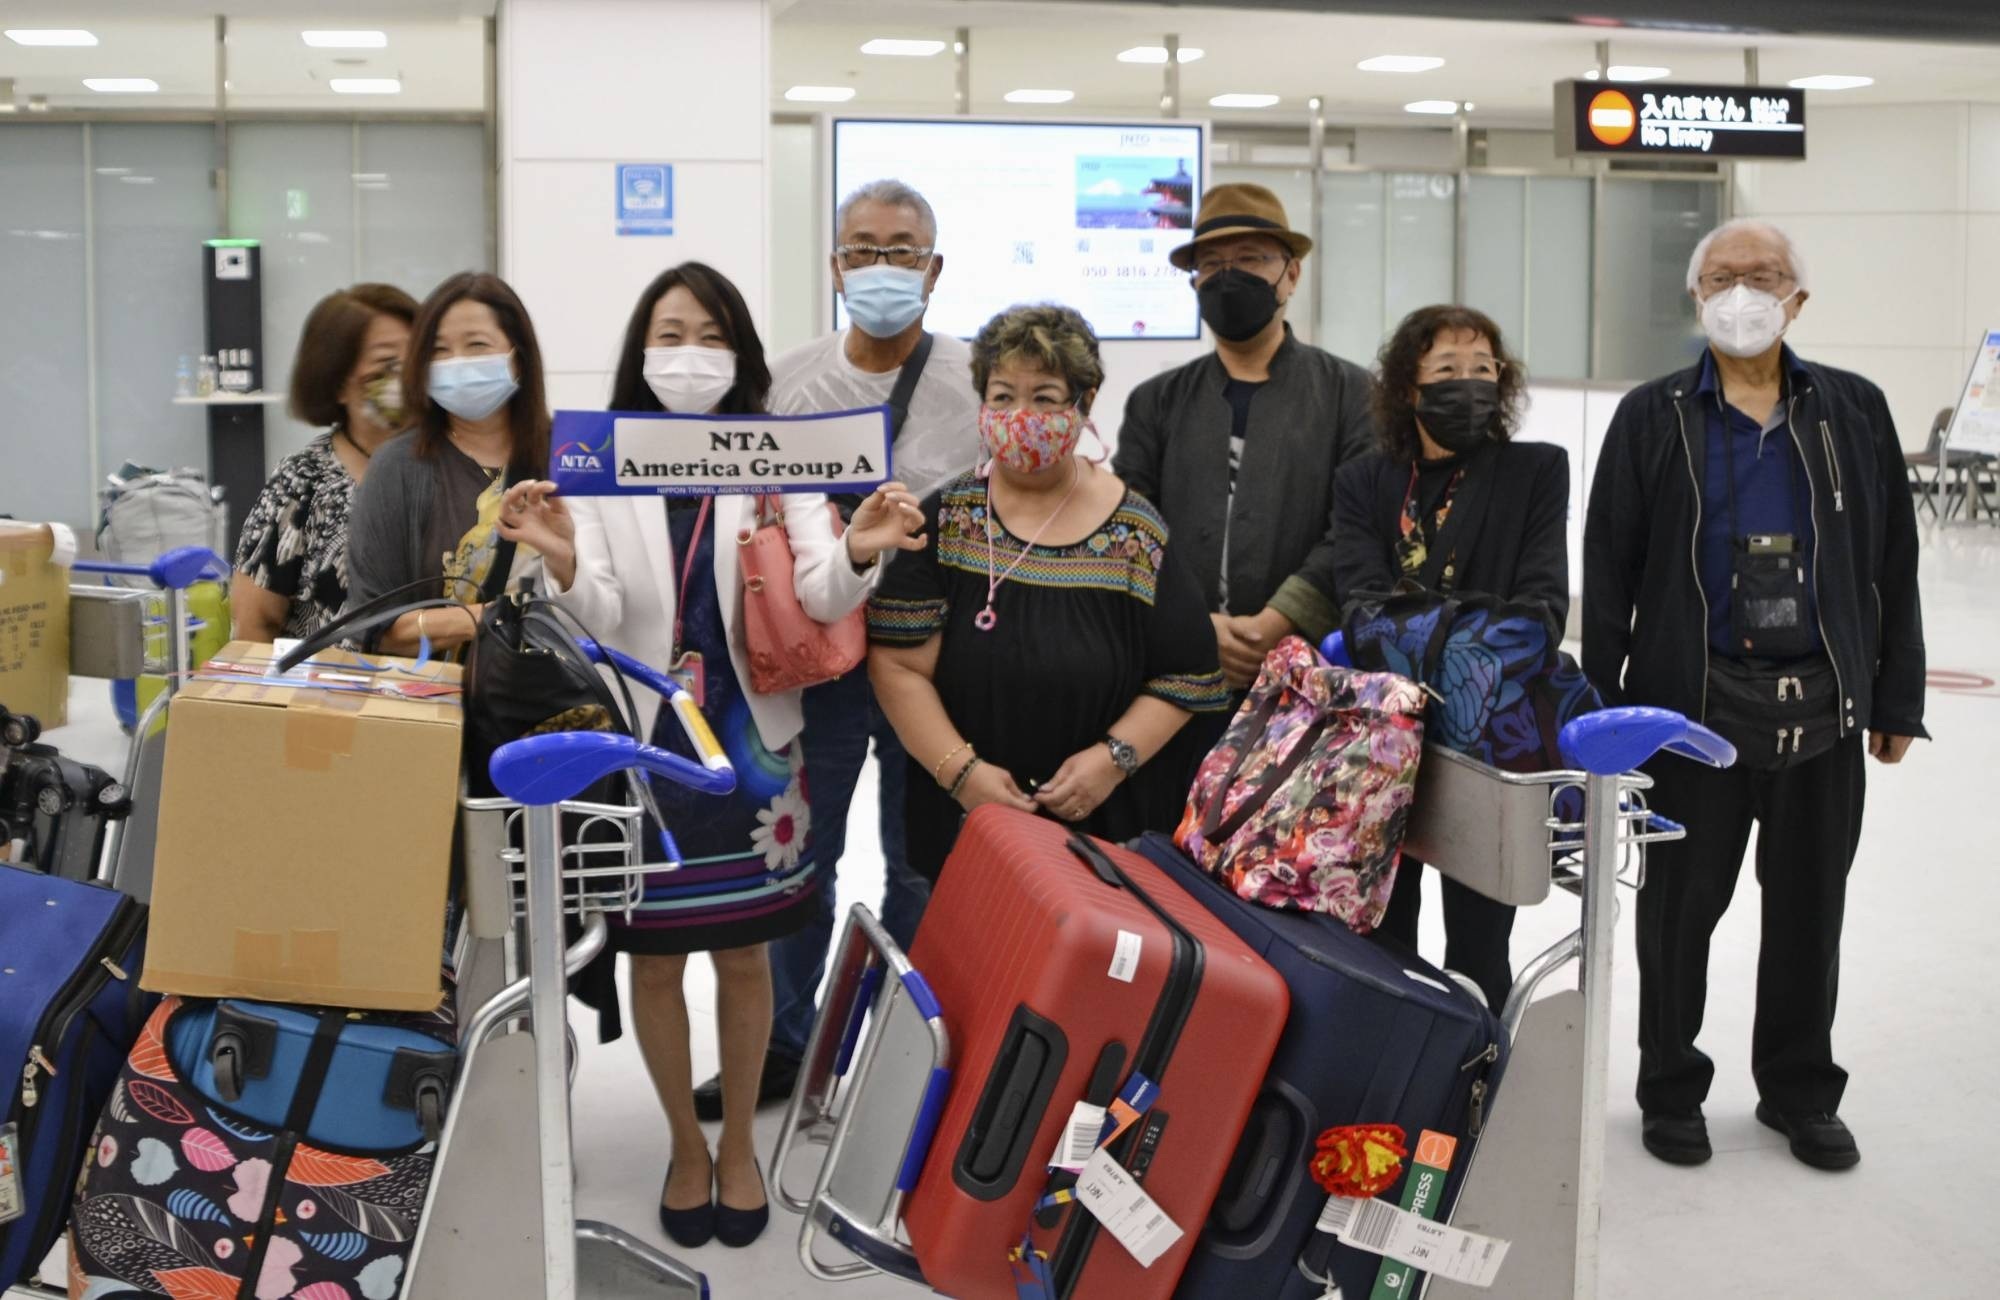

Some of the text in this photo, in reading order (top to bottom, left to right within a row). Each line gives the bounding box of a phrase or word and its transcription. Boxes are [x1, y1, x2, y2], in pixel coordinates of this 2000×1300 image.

[1640, 93, 1746, 122] 入れません
[1640, 126, 1714, 152] No Entry
[709, 431, 780, 452] NTA
[560, 454, 602, 468] NTA
[617, 454, 875, 480] America Group A
[656, 486, 685, 495] NIPPON
[687, 486, 716, 495] TRAVEL
[716, 486, 749, 495] AGENCY
[1085, 1182, 1104, 1201] NRT
[1411, 1244, 1430, 1260] NRT
